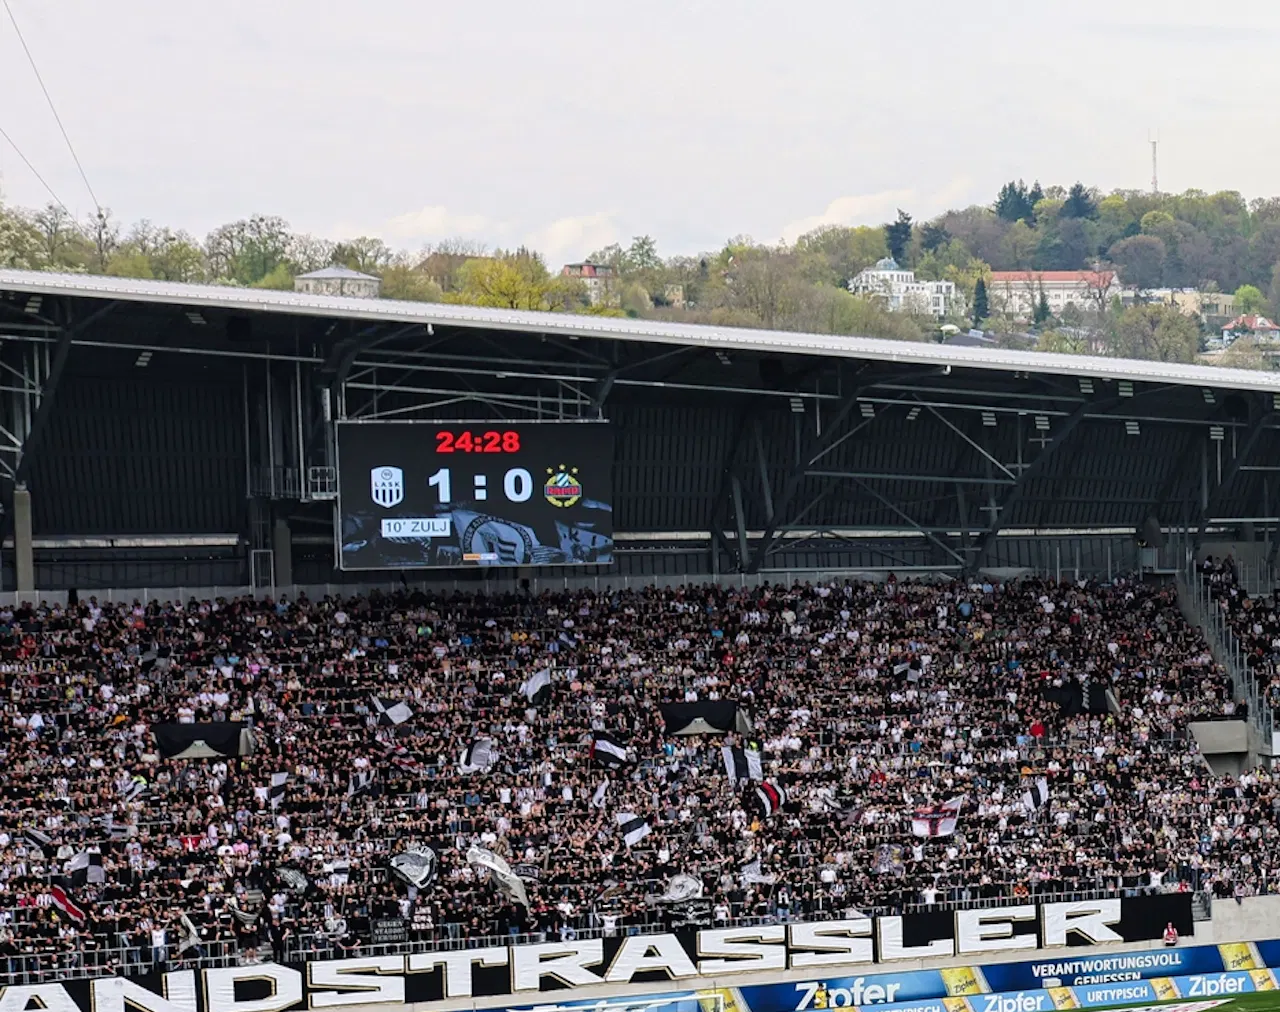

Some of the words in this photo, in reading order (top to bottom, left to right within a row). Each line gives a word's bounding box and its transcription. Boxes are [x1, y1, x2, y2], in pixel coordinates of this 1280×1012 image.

[436, 431, 520, 453] 24:28
[428, 468, 450, 502] 1
[504, 468, 533, 502] 0
[411, 520, 447, 533] ZULJ
[1032, 953, 1181, 977] VERANTWORTUNGSVOLL
[1074, 971, 1141, 985] GENIESSEN
[1189, 974, 1247, 996] Zipfer
[795, 978, 900, 1011] Zpfer
[1087, 986, 1148, 1003] URTYPISCH
